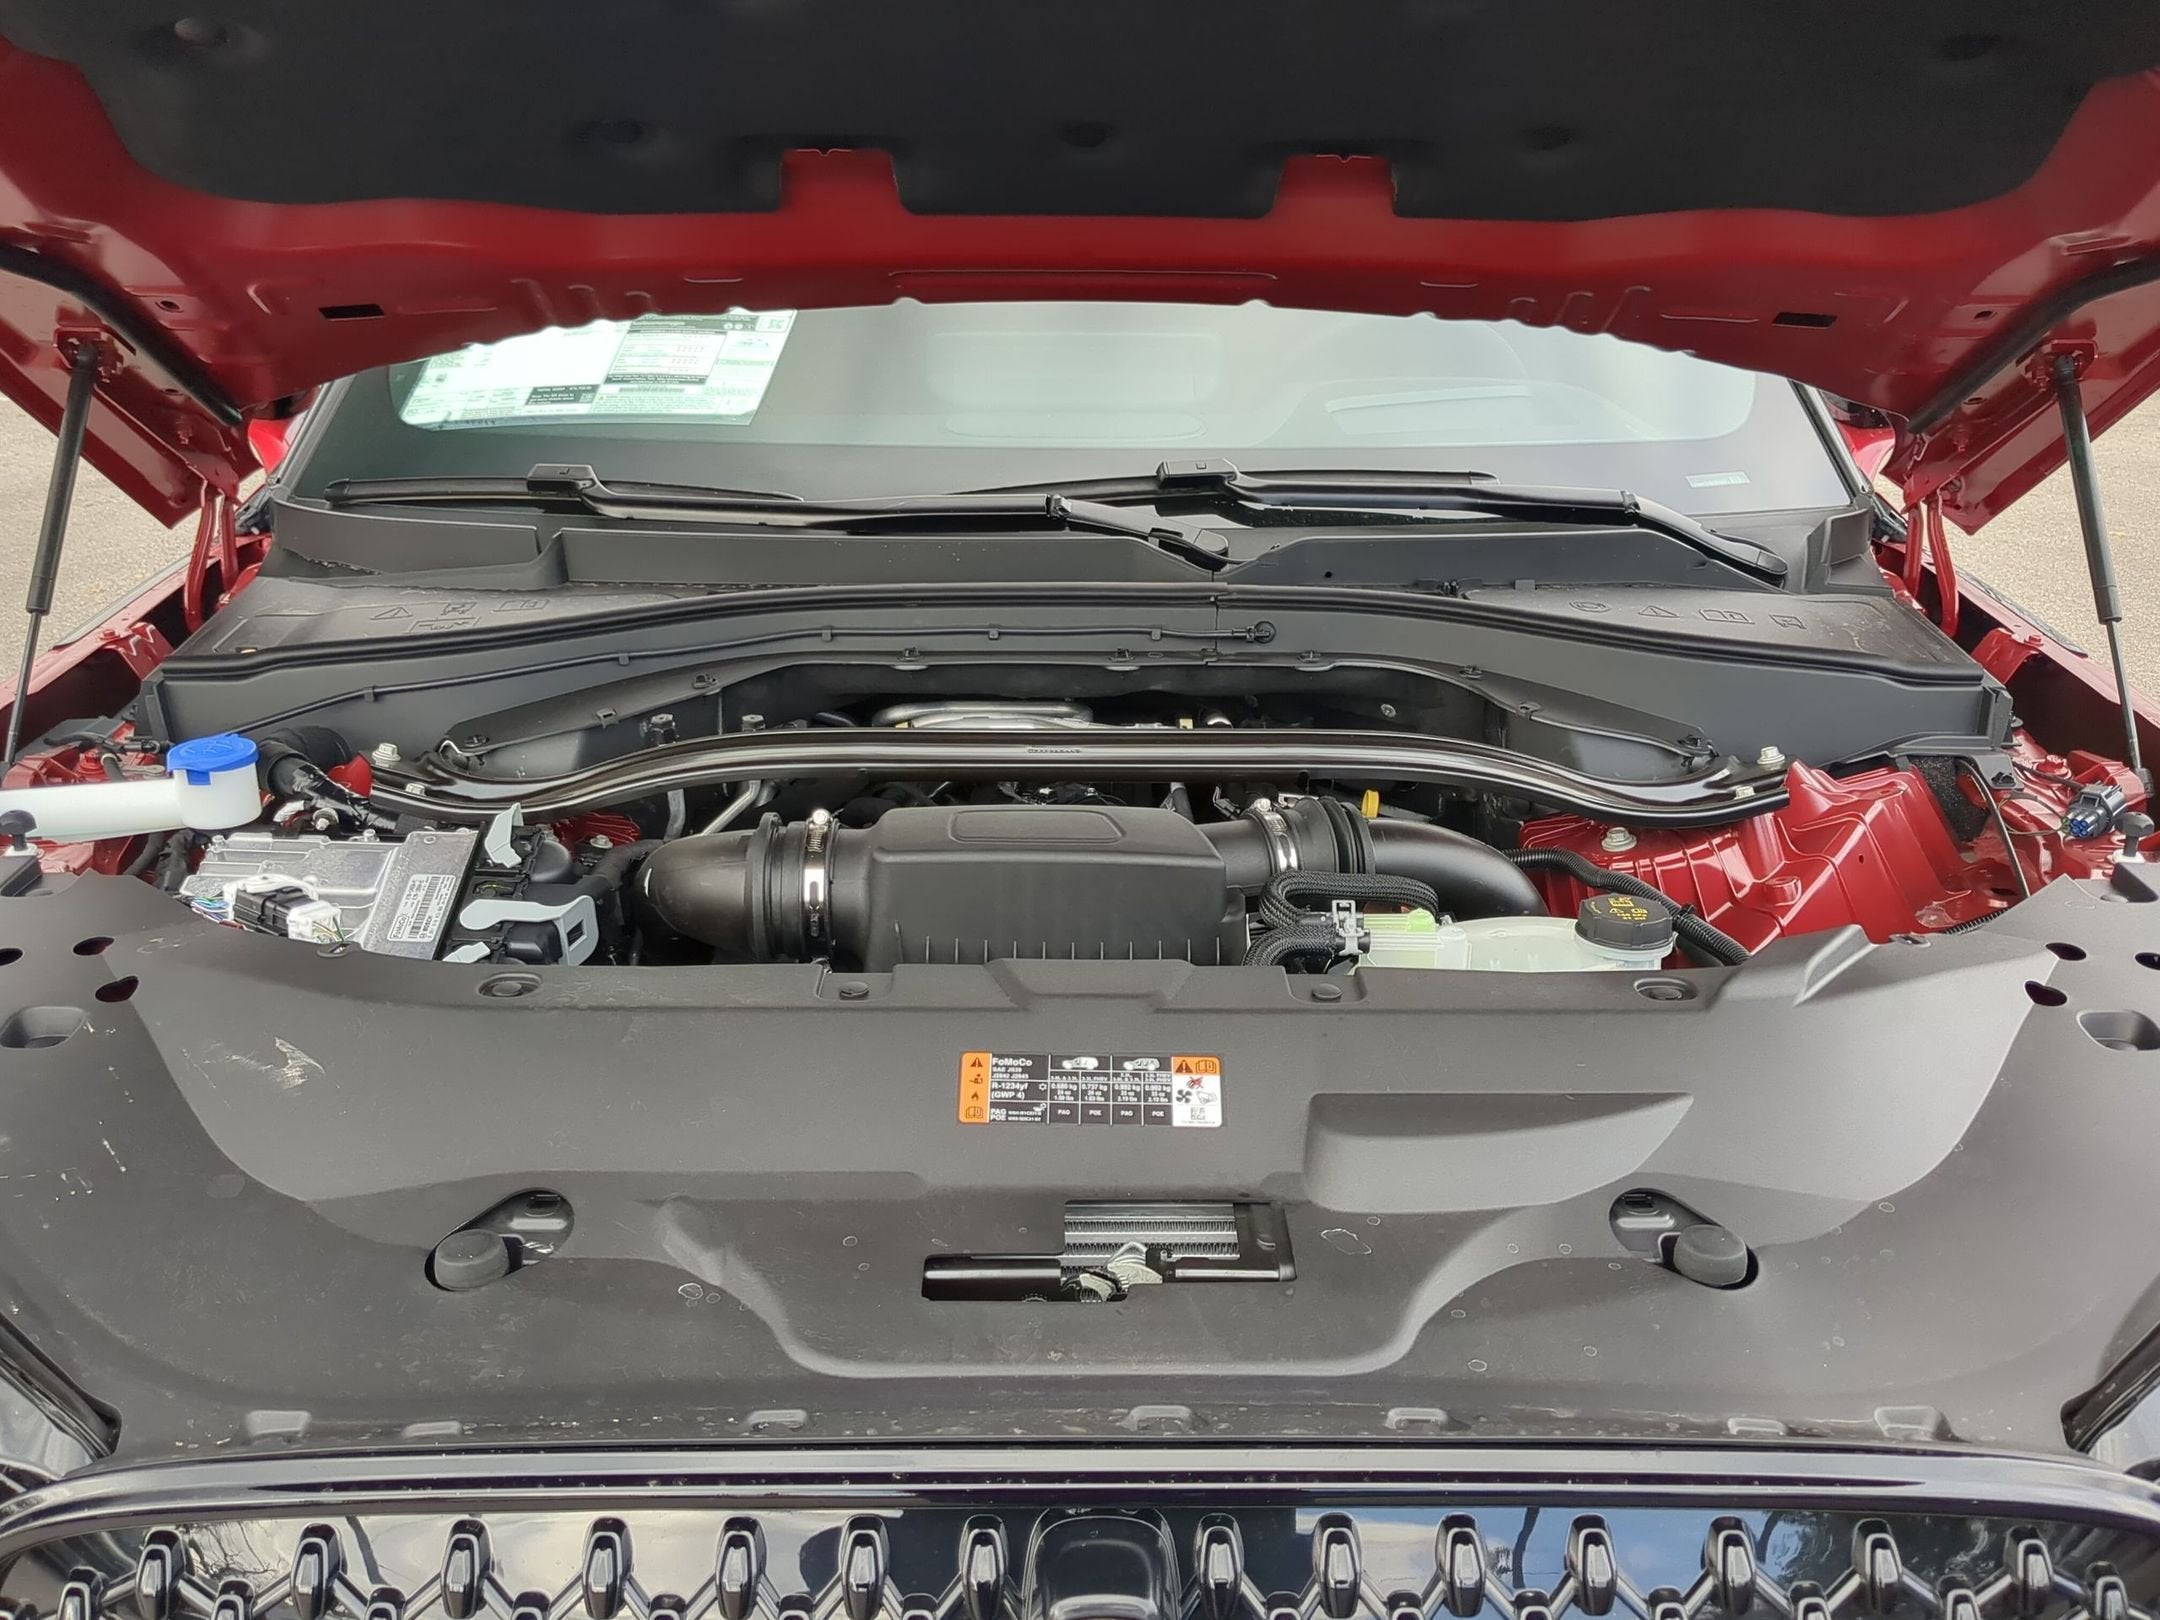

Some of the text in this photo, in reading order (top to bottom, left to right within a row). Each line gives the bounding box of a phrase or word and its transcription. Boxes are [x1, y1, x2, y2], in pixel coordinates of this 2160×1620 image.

[992, 1057, 1033, 1066] FoMoCo
[991, 1082, 1029, 1091] R-1234yf
[1069, 1083, 1078, 1091] kg
[991, 1091, 1025, 1100] (GWP 4)
